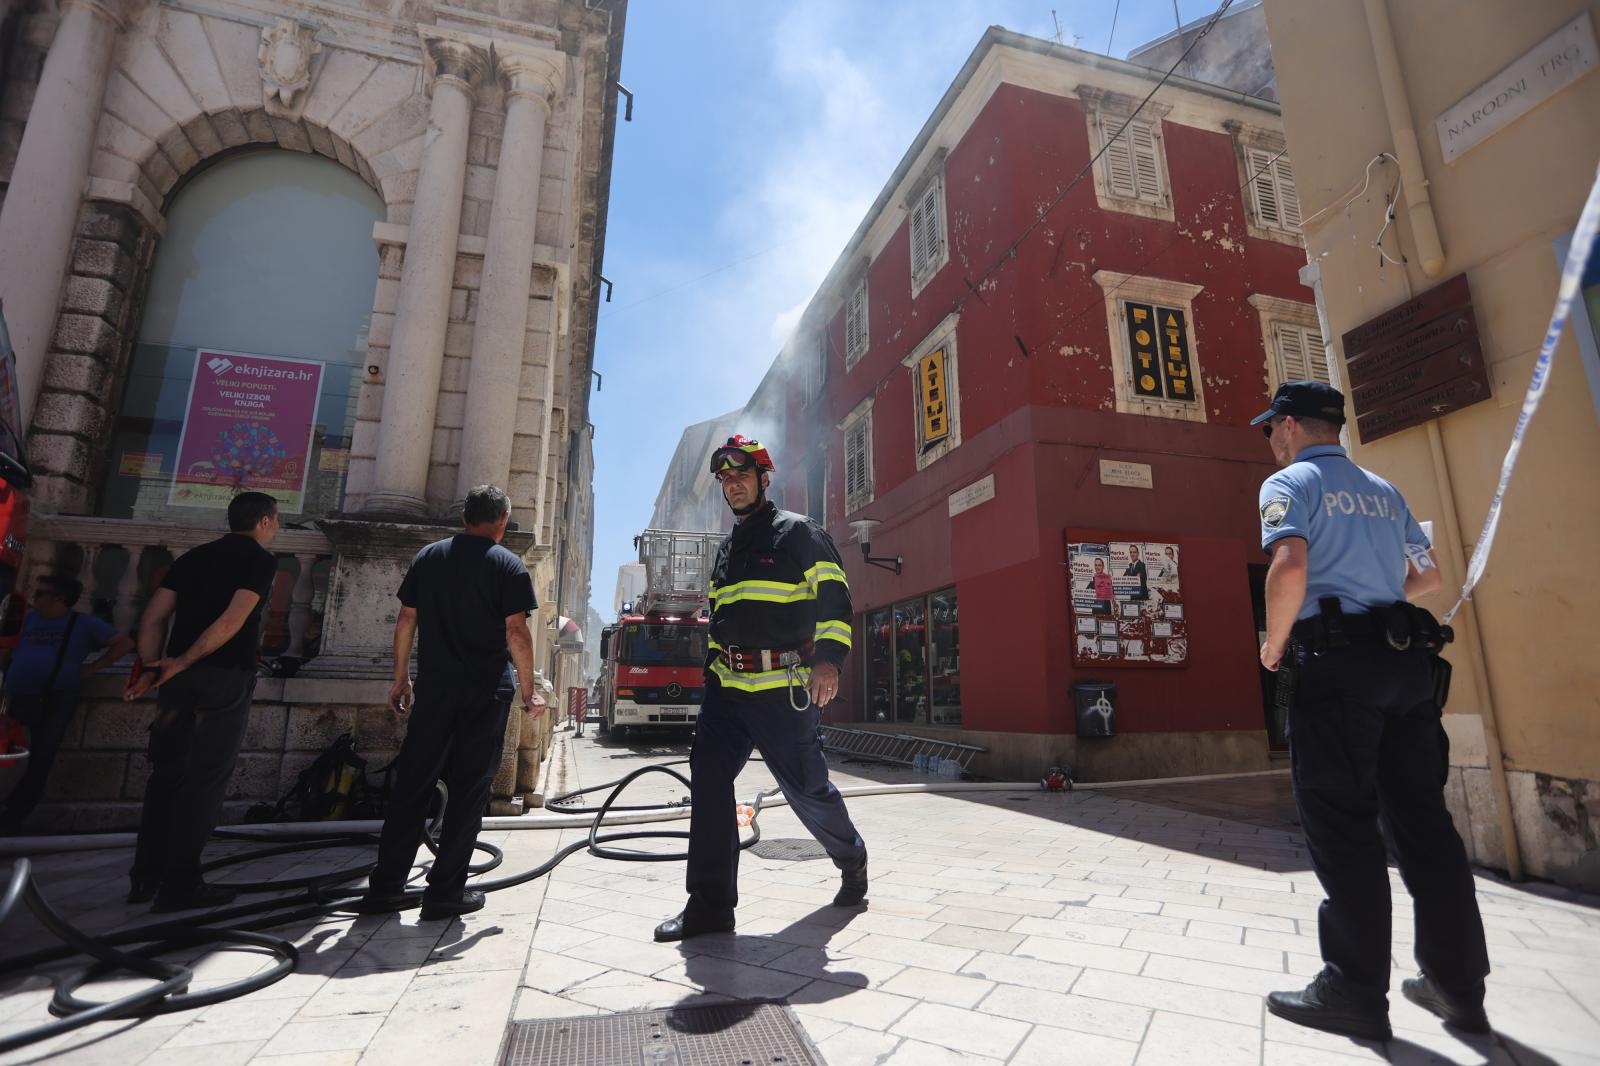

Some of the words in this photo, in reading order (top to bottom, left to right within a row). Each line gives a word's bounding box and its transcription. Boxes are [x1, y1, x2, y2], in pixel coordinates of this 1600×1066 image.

[1447, 78, 1528, 140] NARODNI
[234, 364, 313, 381] eknjizara.hr
[1133, 308, 1156, 391] FOTO
